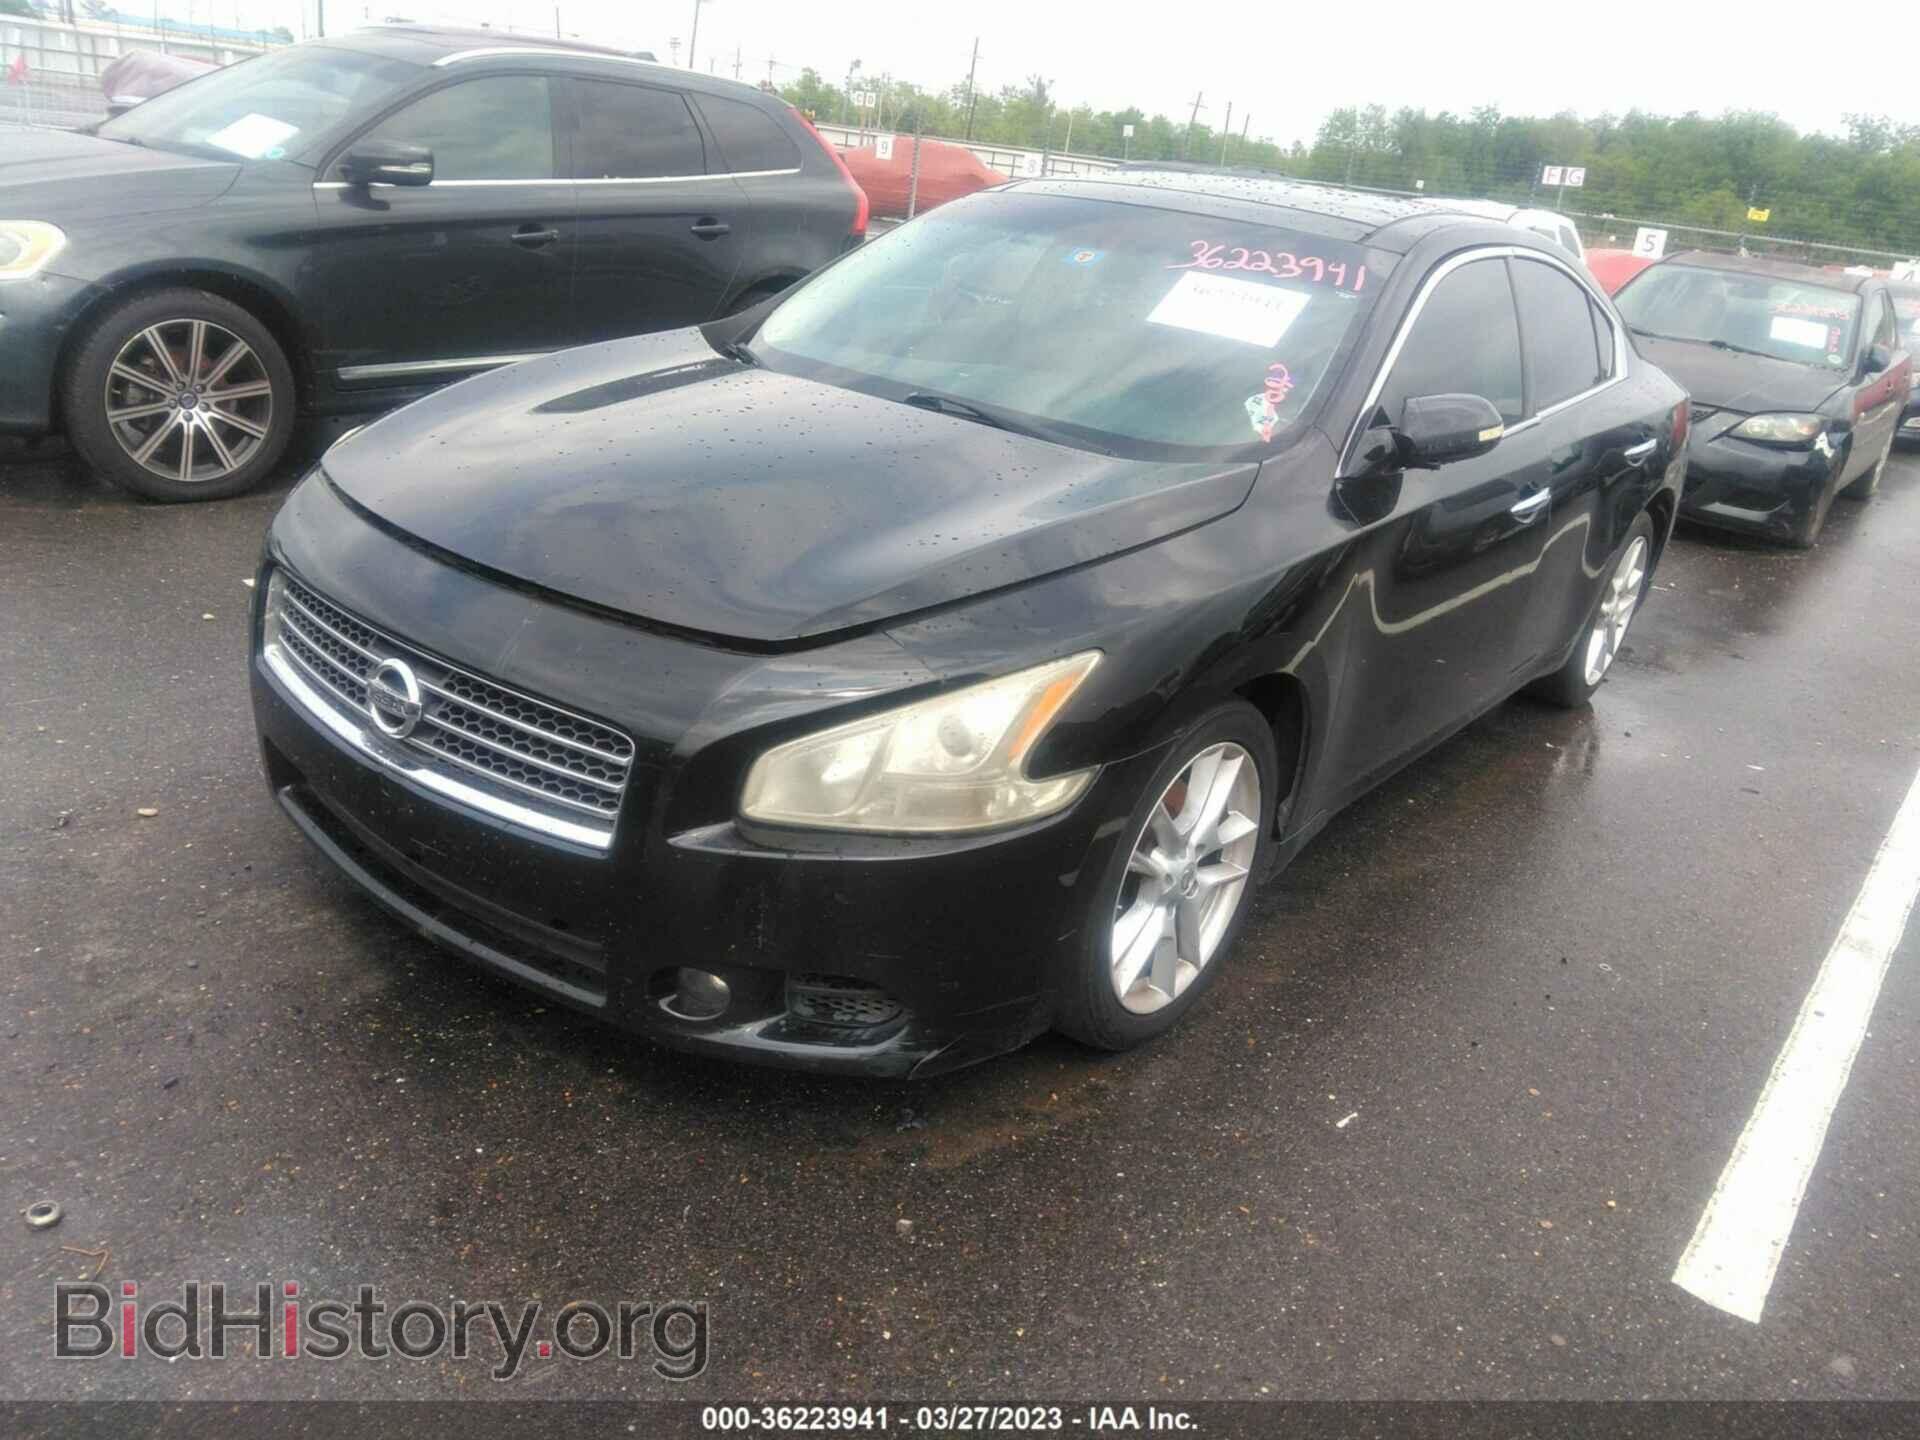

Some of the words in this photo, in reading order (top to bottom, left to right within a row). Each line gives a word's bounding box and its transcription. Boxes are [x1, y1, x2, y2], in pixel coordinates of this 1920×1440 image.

[1546, 167, 1560, 184] F
[1568, 168, 1583, 185] G
[1643, 235, 1658, 252] 5
[1167, 239, 1367, 292] 36223941
